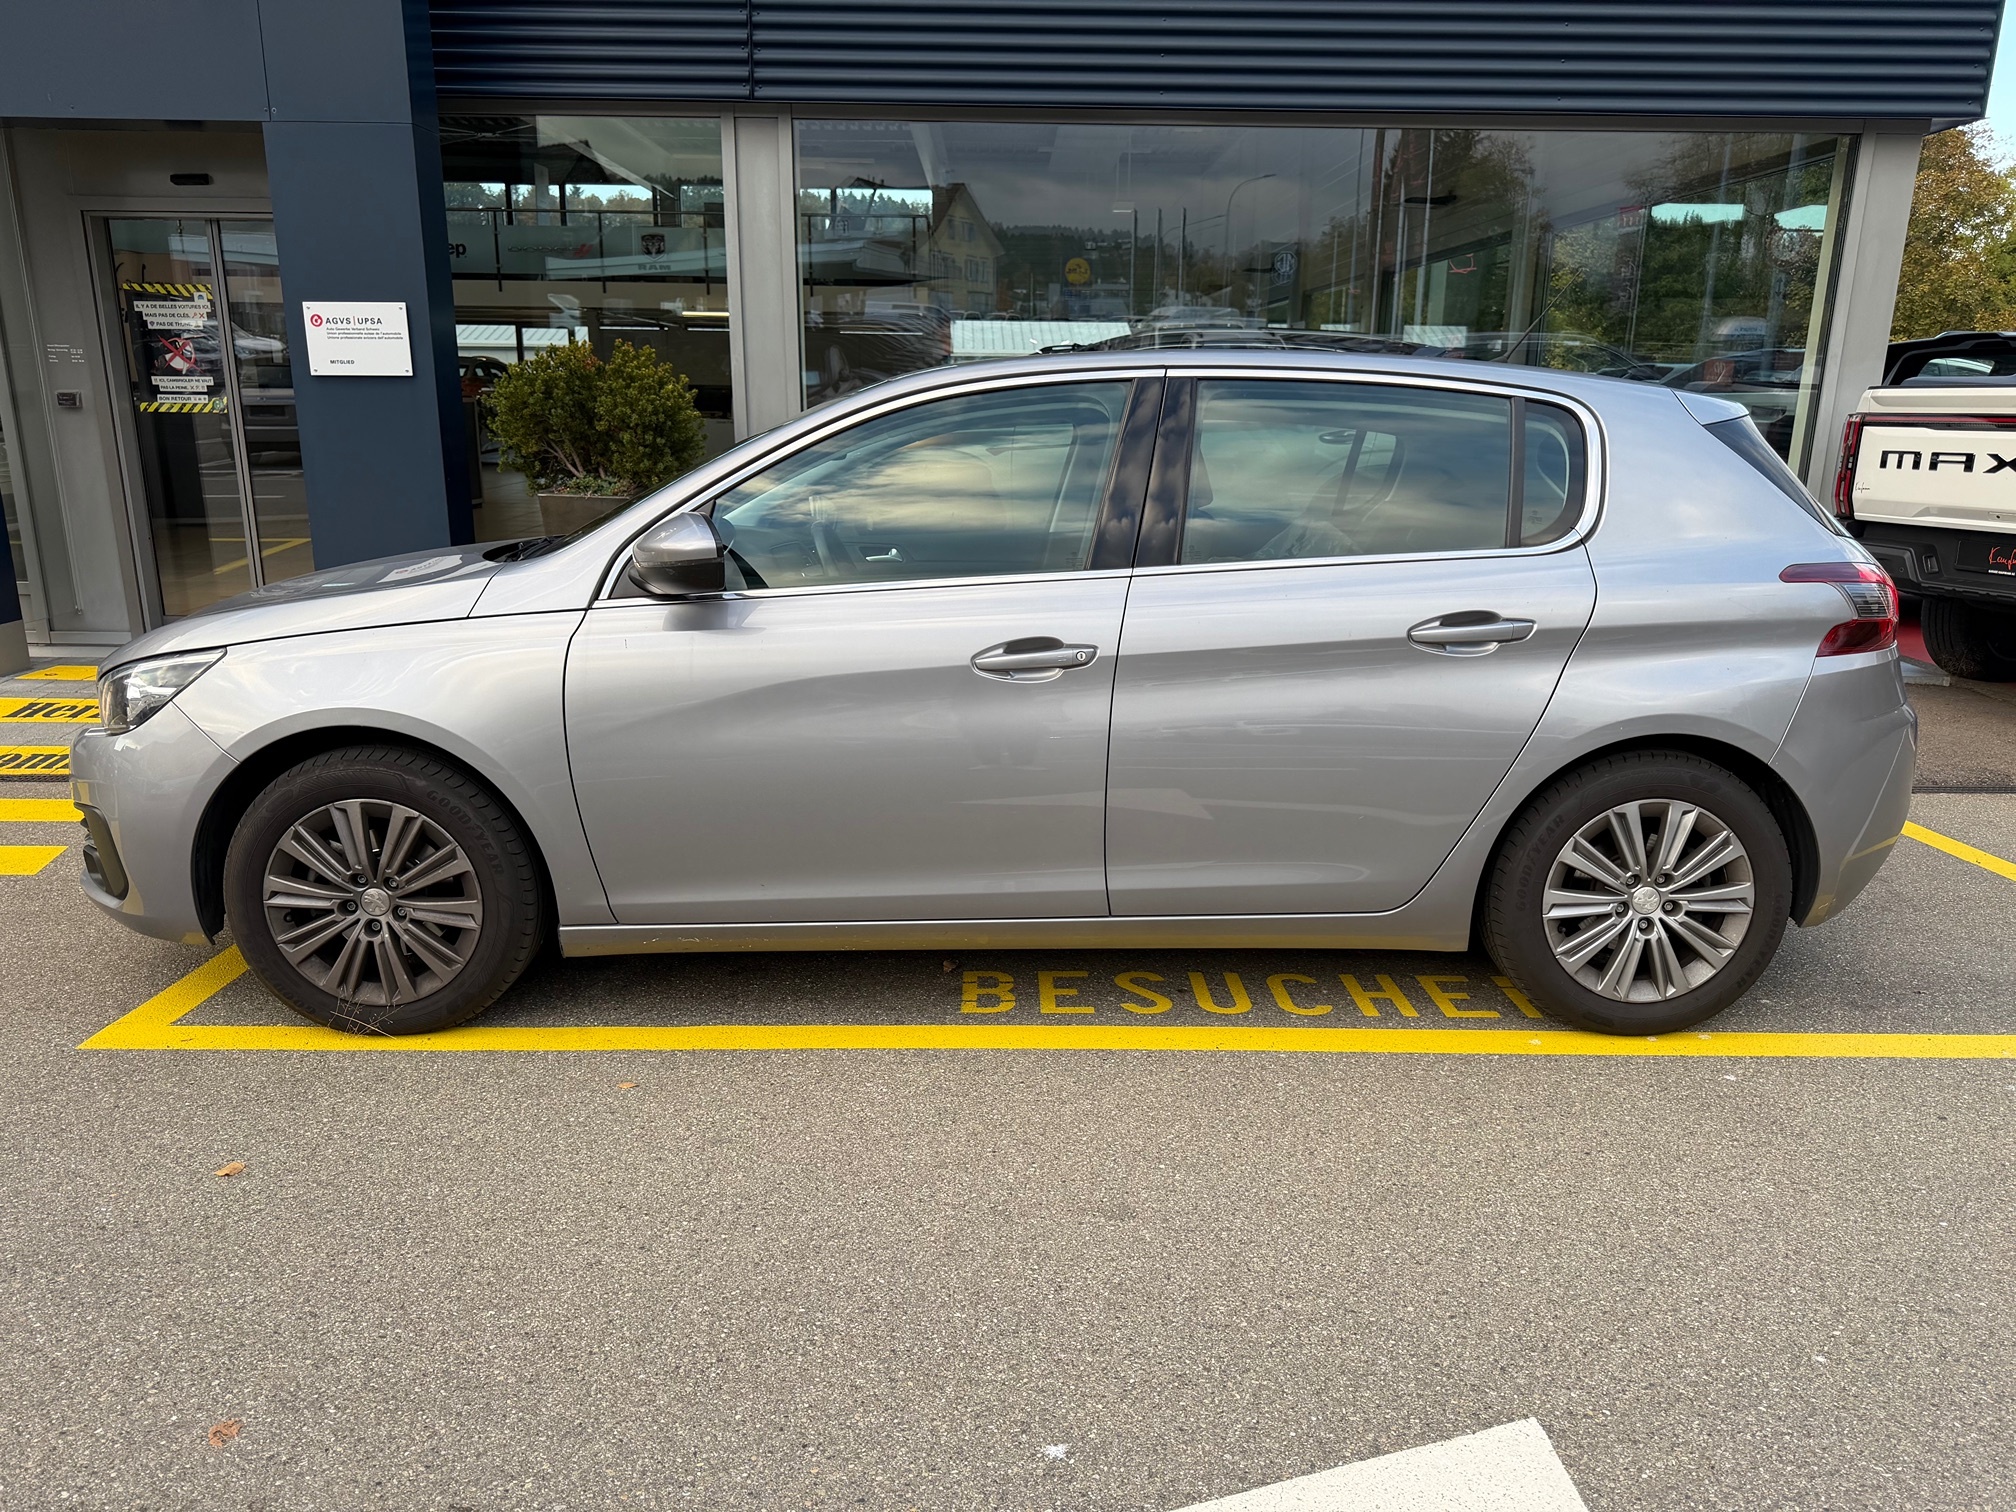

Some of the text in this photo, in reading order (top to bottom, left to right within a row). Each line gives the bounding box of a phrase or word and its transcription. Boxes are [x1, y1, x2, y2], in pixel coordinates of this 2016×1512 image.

[638, 263, 671, 271] RAM
[325, 316, 383, 325] AGVS UPSA
[1879, 450, 2016, 474] MAX
